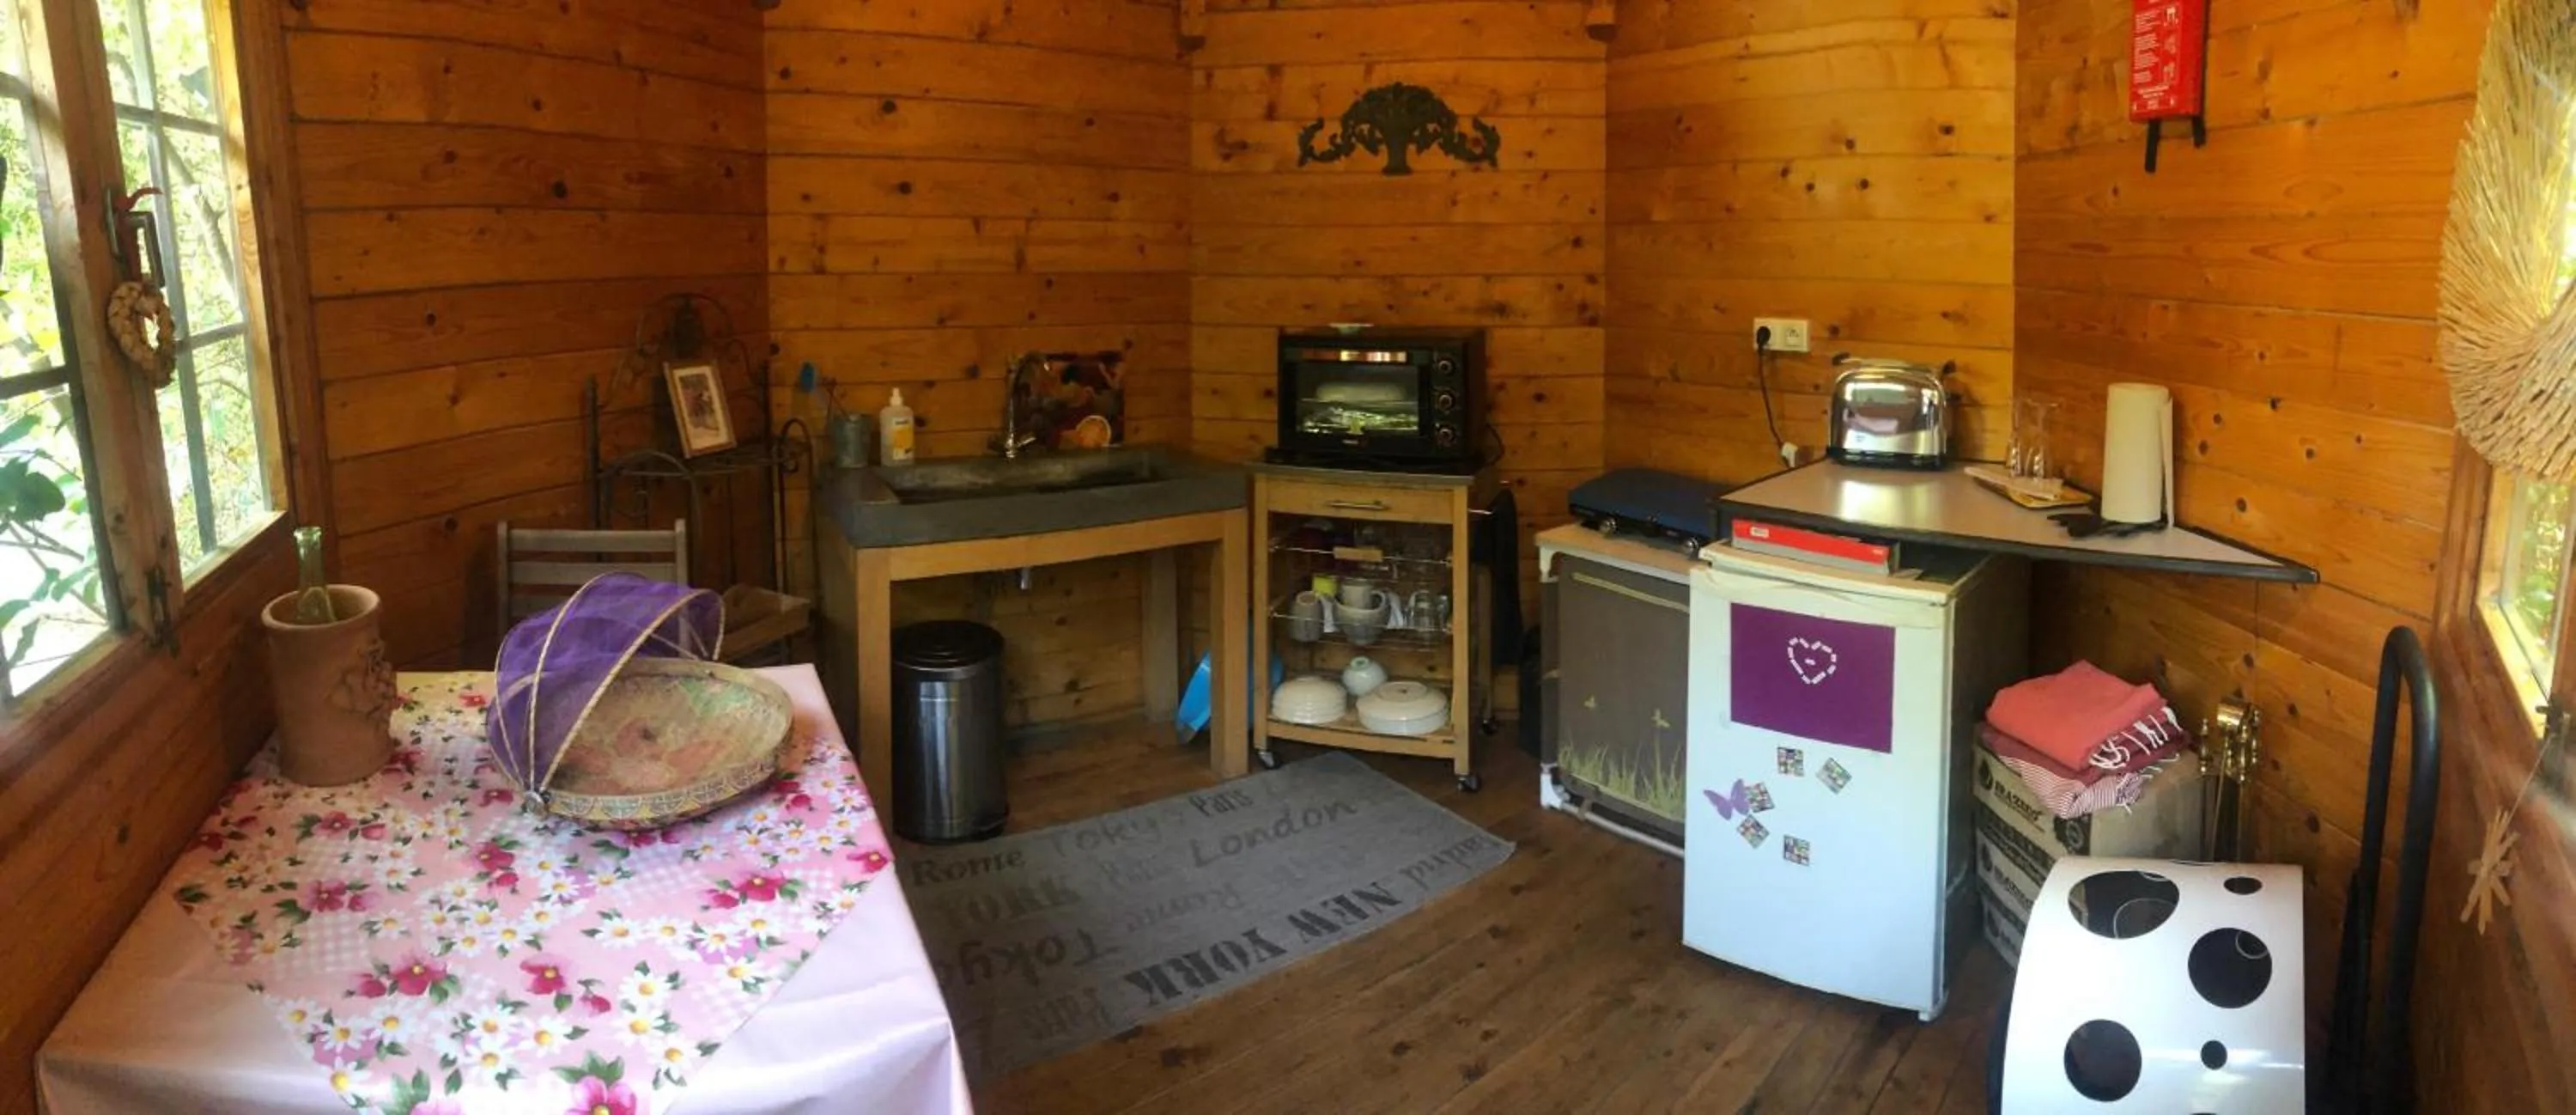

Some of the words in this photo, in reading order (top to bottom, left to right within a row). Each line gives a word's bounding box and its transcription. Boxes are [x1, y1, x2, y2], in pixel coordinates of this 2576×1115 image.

[1190, 798, 1358, 867] London
[1191, 789, 1253, 818] Paris
[910, 849, 1023, 887] Rome
[1400, 832, 1489, 891] adrid
[1287, 881, 1401, 943] NEW
[1123, 929, 1286, 1005] YORK
